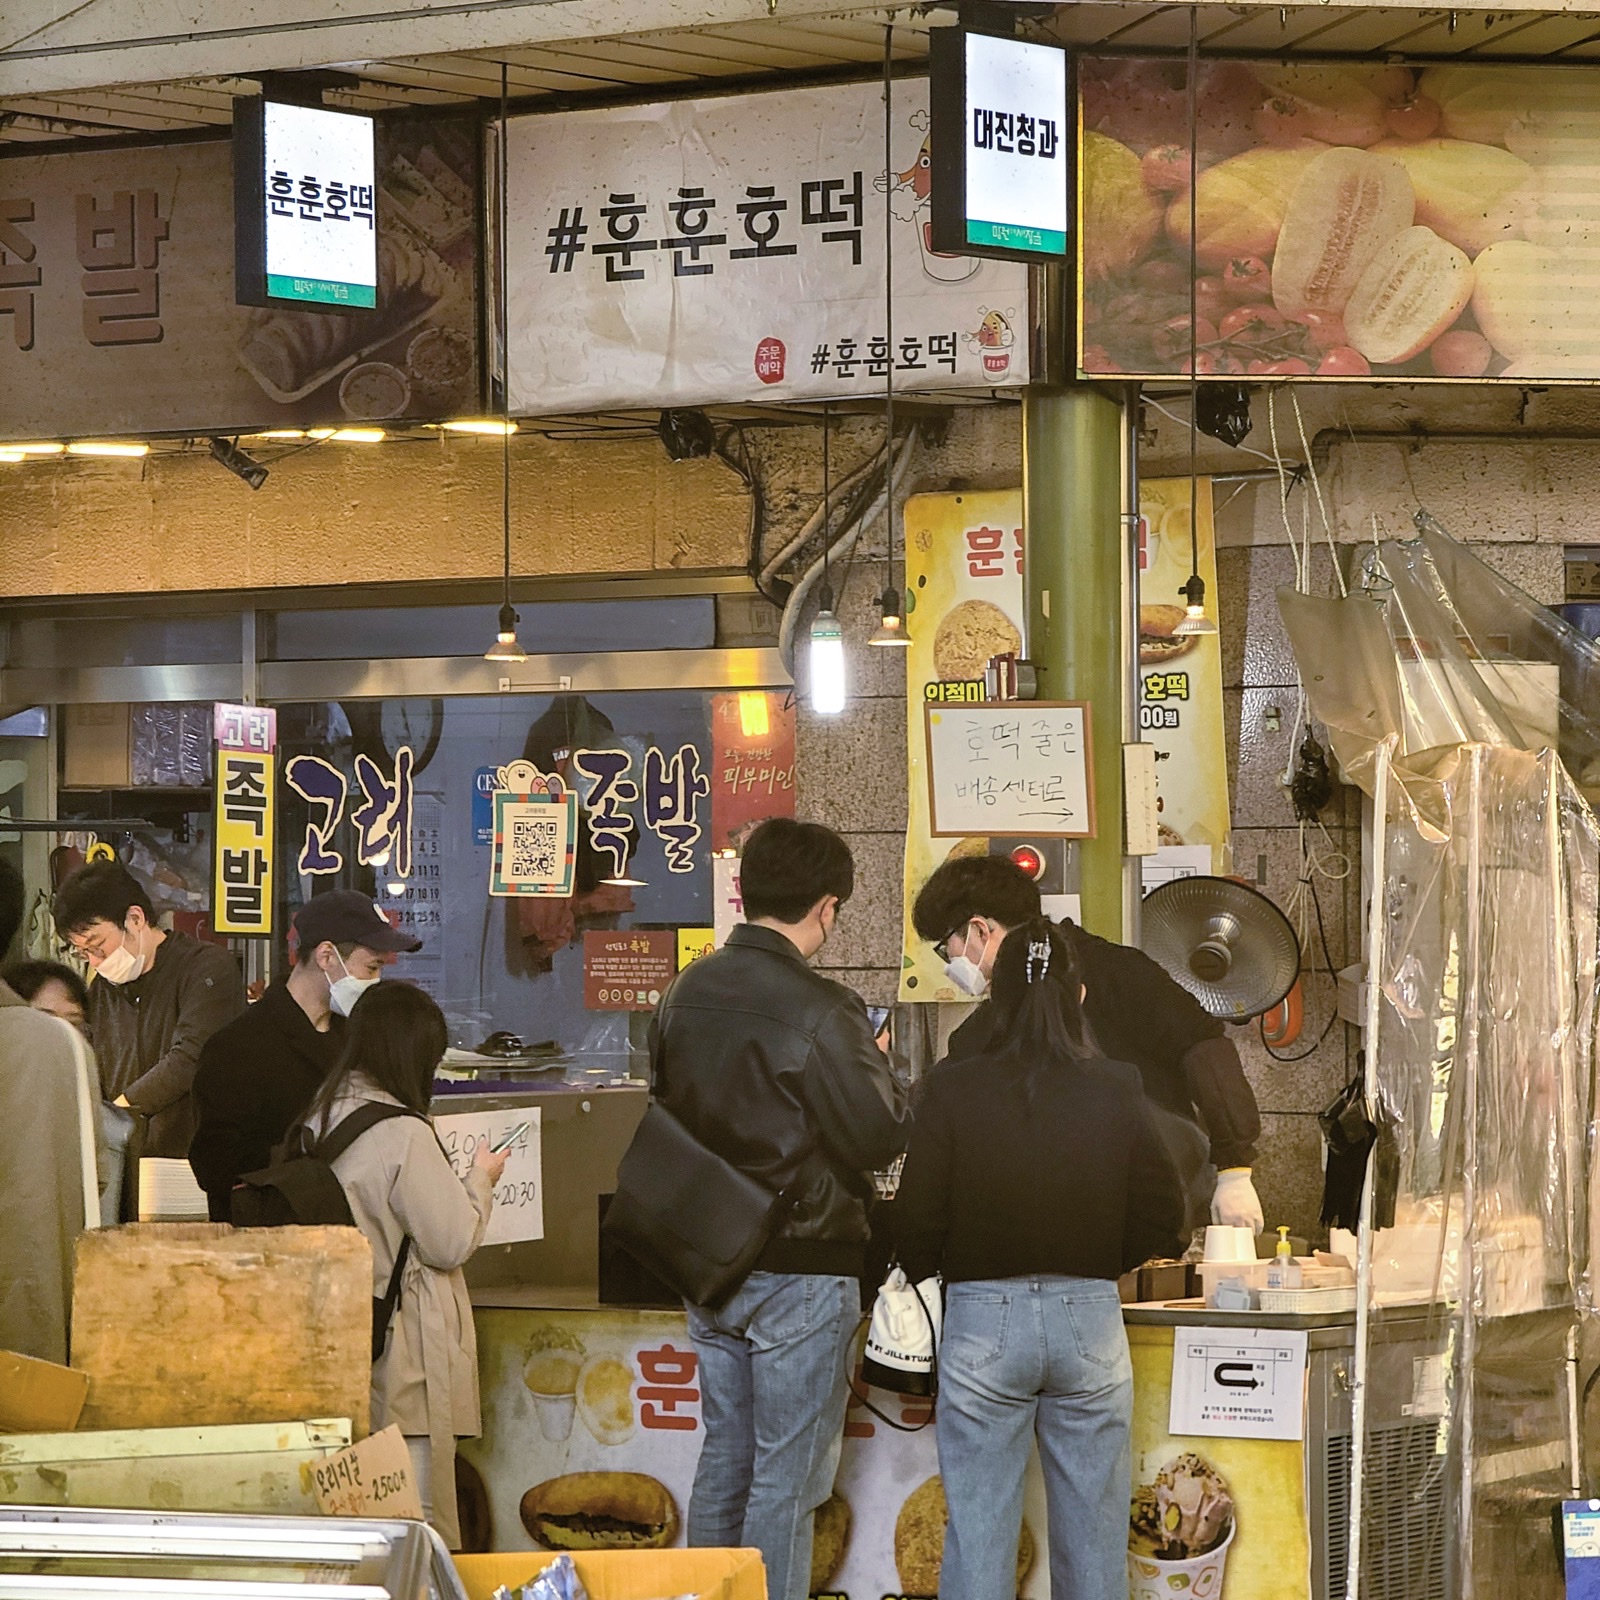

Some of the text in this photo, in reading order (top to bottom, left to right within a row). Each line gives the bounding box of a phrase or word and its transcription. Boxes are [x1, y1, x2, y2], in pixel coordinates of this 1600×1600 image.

[973, 107, 1059, 160] 대진청과
[267, 169, 374, 231] 훈훈호떡
[544, 171, 863, 282] #훈훈호떡
[758, 360, 782, 375] 예약
[759, 345, 781, 360] 주문
[810, 332, 957, 379] #훈훈호떡
[1144, 671, 1189, 701] 호떡
[221, 711, 269, 752] 고려
[965, 719, 1076, 763] 호떡 줄은
[723, 764, 794, 795] 피부미인
[286, 744, 711, 878] 고려 족발
[222, 758, 268, 925] 족발
